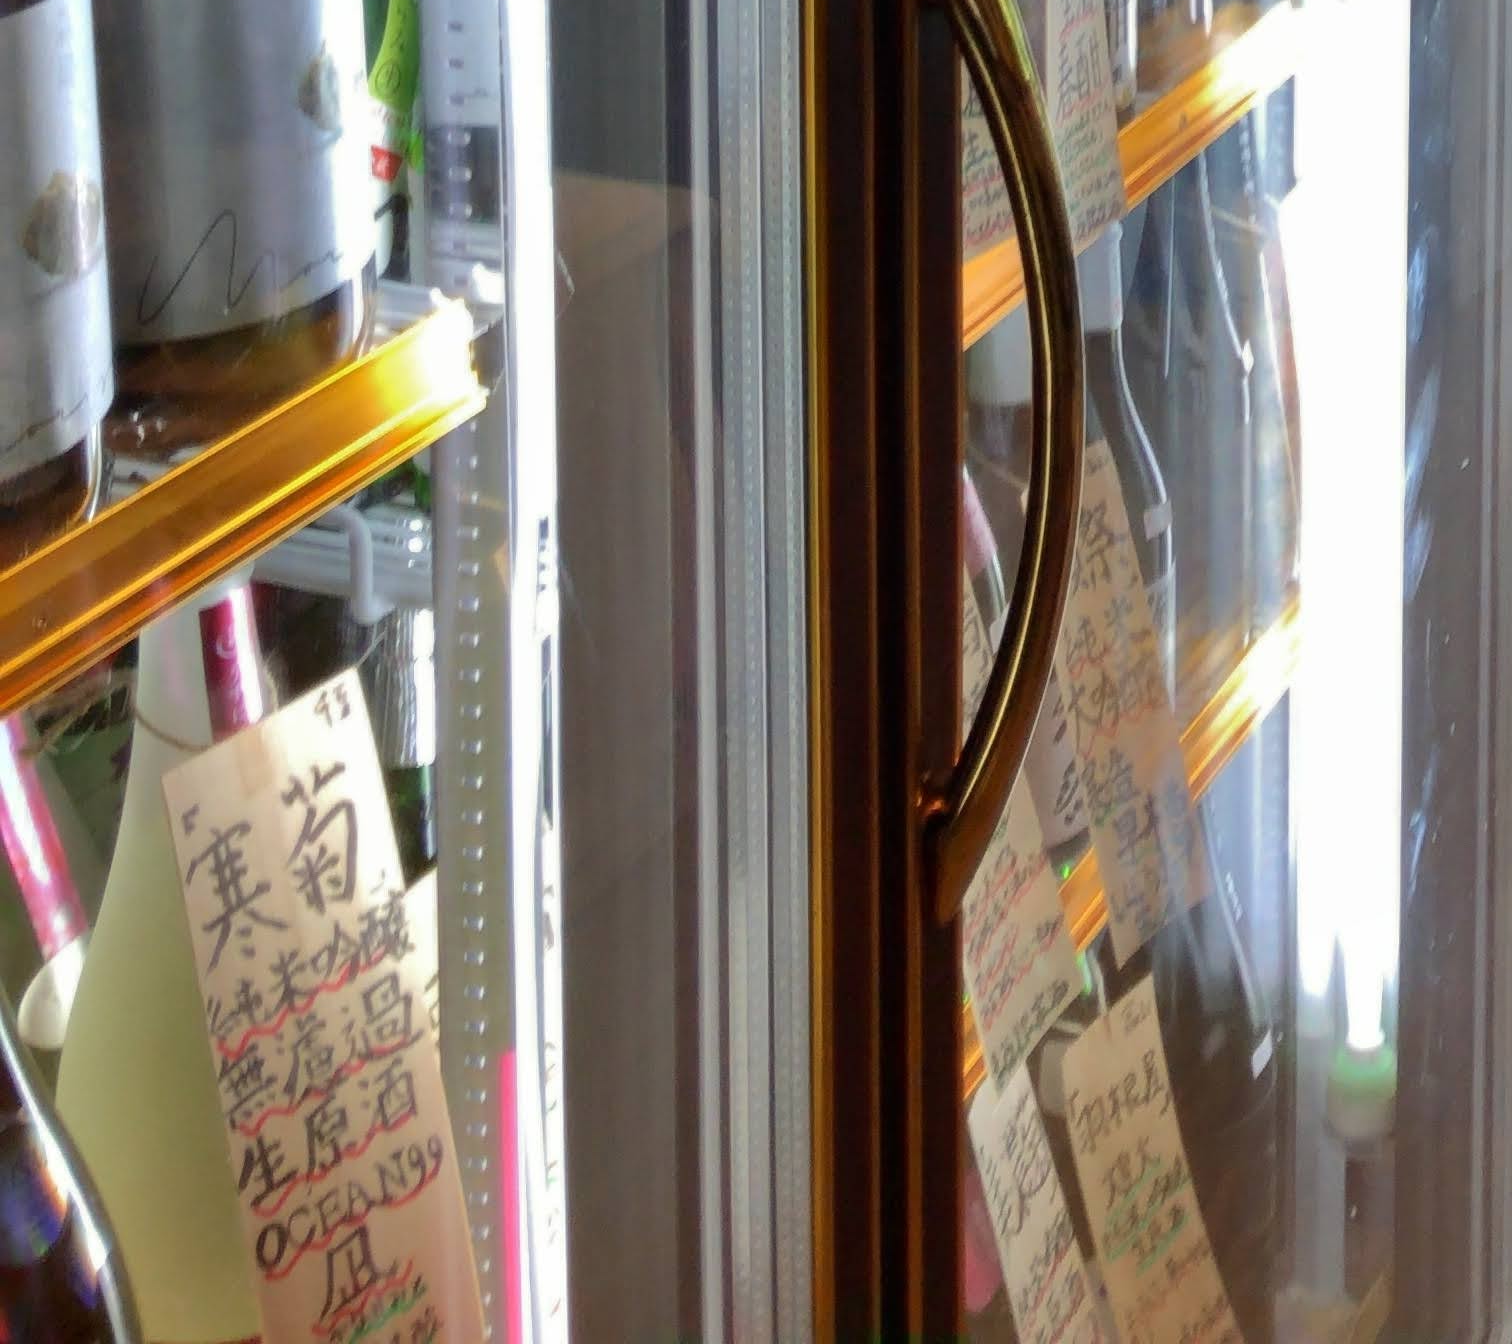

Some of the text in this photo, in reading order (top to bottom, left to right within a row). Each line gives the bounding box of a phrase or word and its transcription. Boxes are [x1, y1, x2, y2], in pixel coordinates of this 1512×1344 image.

[204, 897, 416, 1033] 純米吟醸
[216, 970, 424, 1130] 無濾過
[238, 1058, 418, 1209] 生原酒
[320, 1225, 400, 1323] 凪
